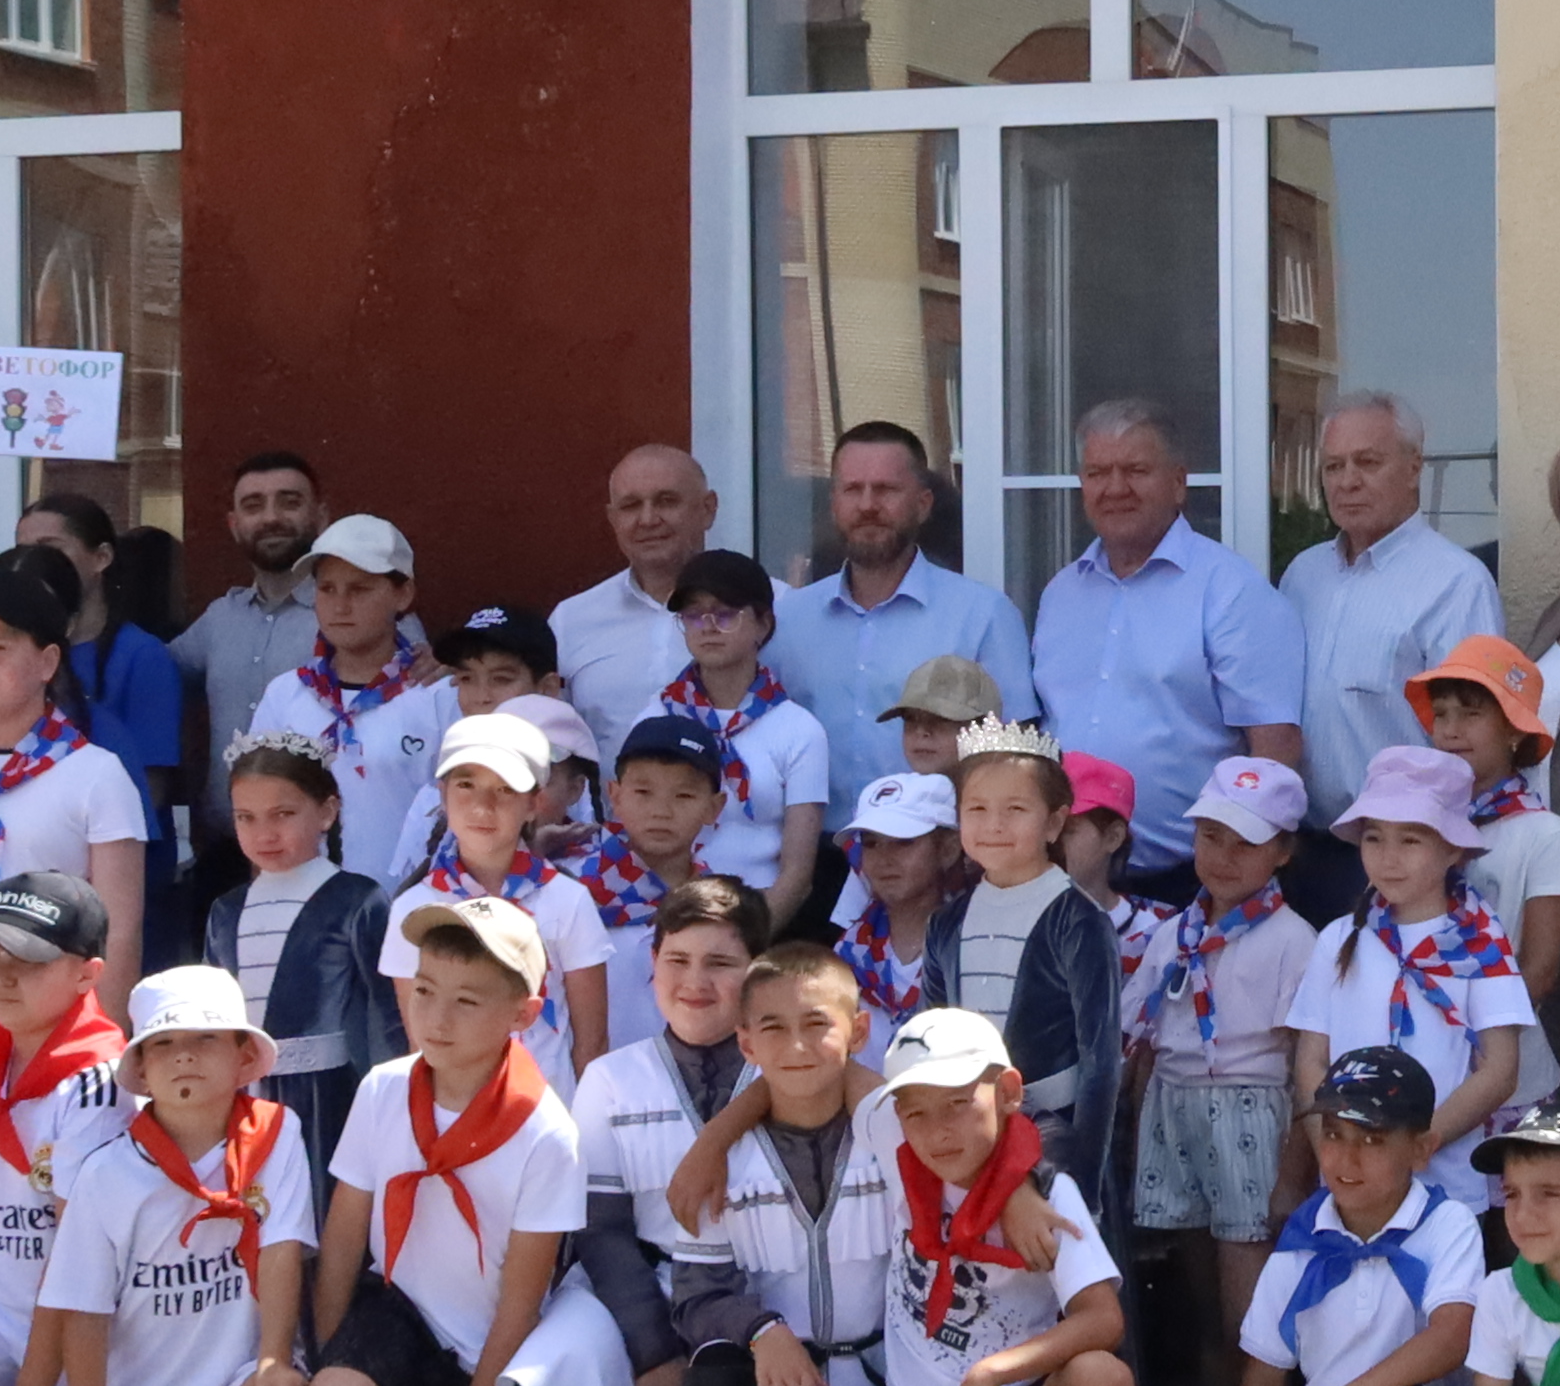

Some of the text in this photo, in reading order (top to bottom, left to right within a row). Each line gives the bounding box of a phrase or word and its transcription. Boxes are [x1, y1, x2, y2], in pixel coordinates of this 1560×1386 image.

[18, 892, 61, 920] Klein
[154, 1293, 183, 1316] FLY
[940, 1328, 965, 1346] CITY
